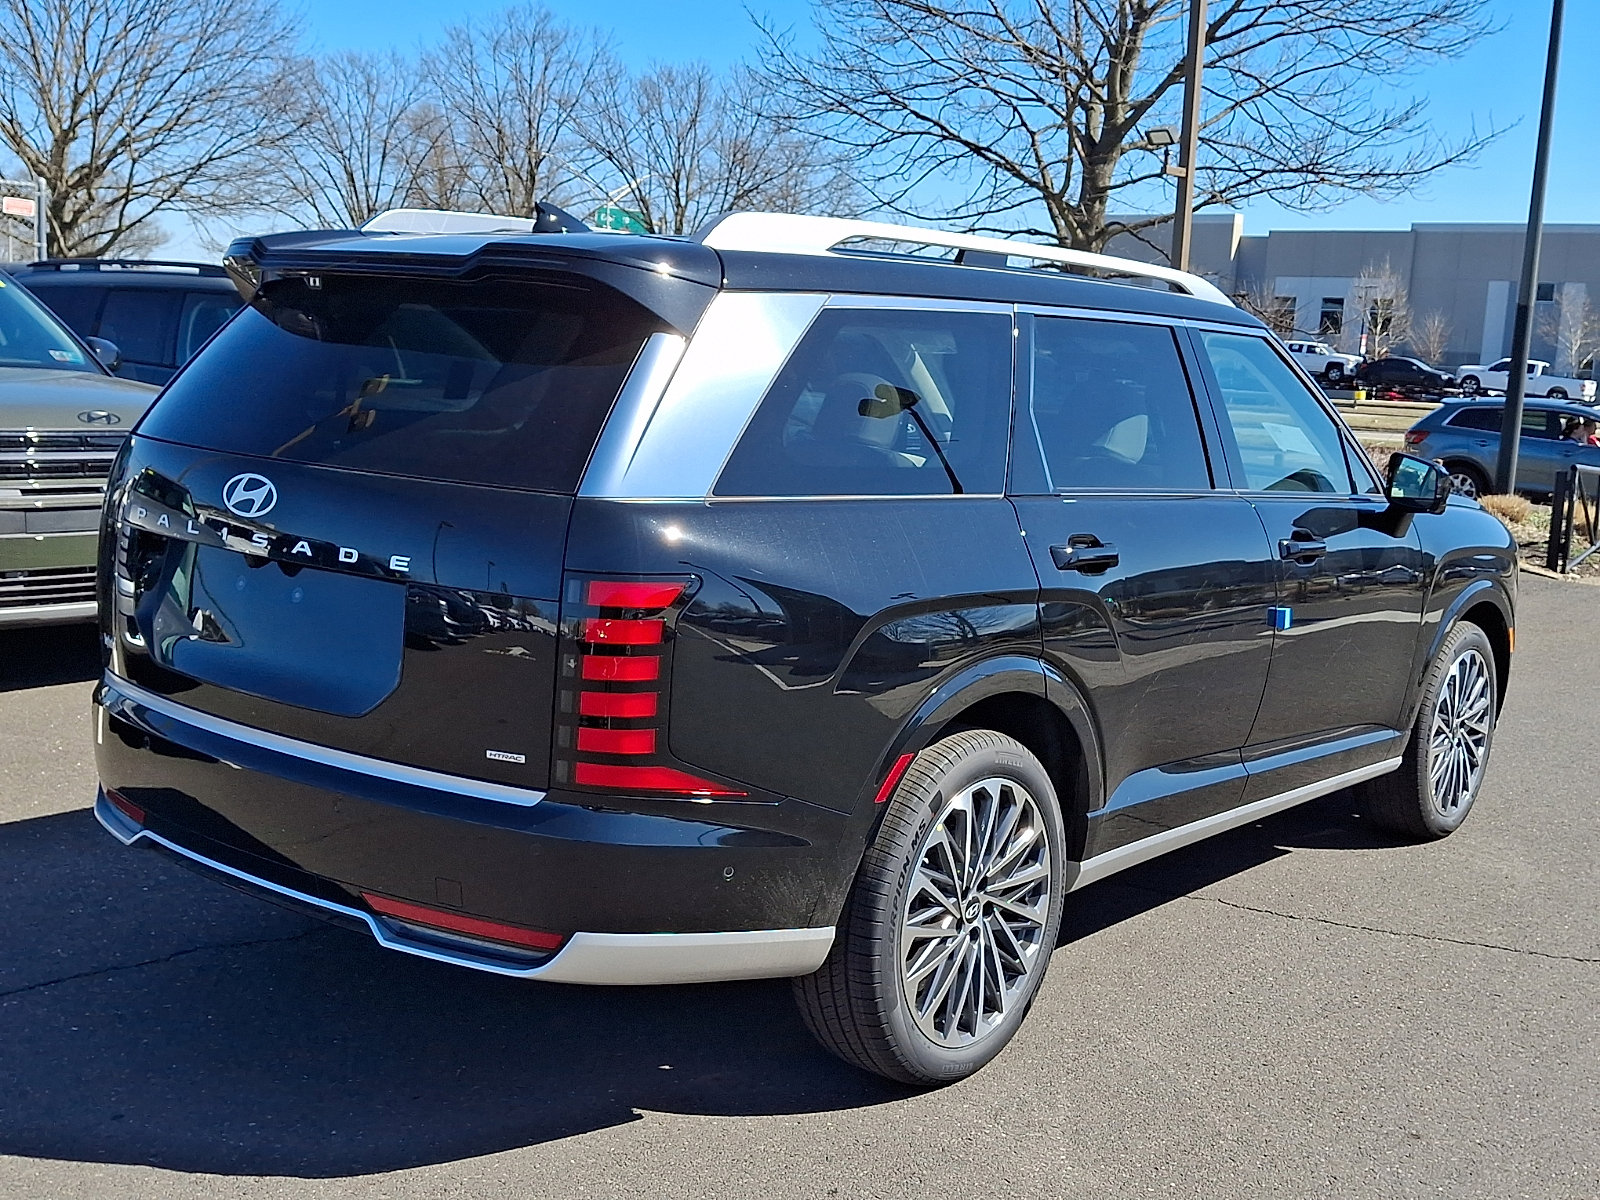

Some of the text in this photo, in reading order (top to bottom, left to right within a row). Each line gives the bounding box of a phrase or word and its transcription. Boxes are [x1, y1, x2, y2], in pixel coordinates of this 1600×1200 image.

[136, 507, 412, 572] PALISADE
[488, 751, 525, 762] HTRAC
[888, 855, 910, 971] CORPION
